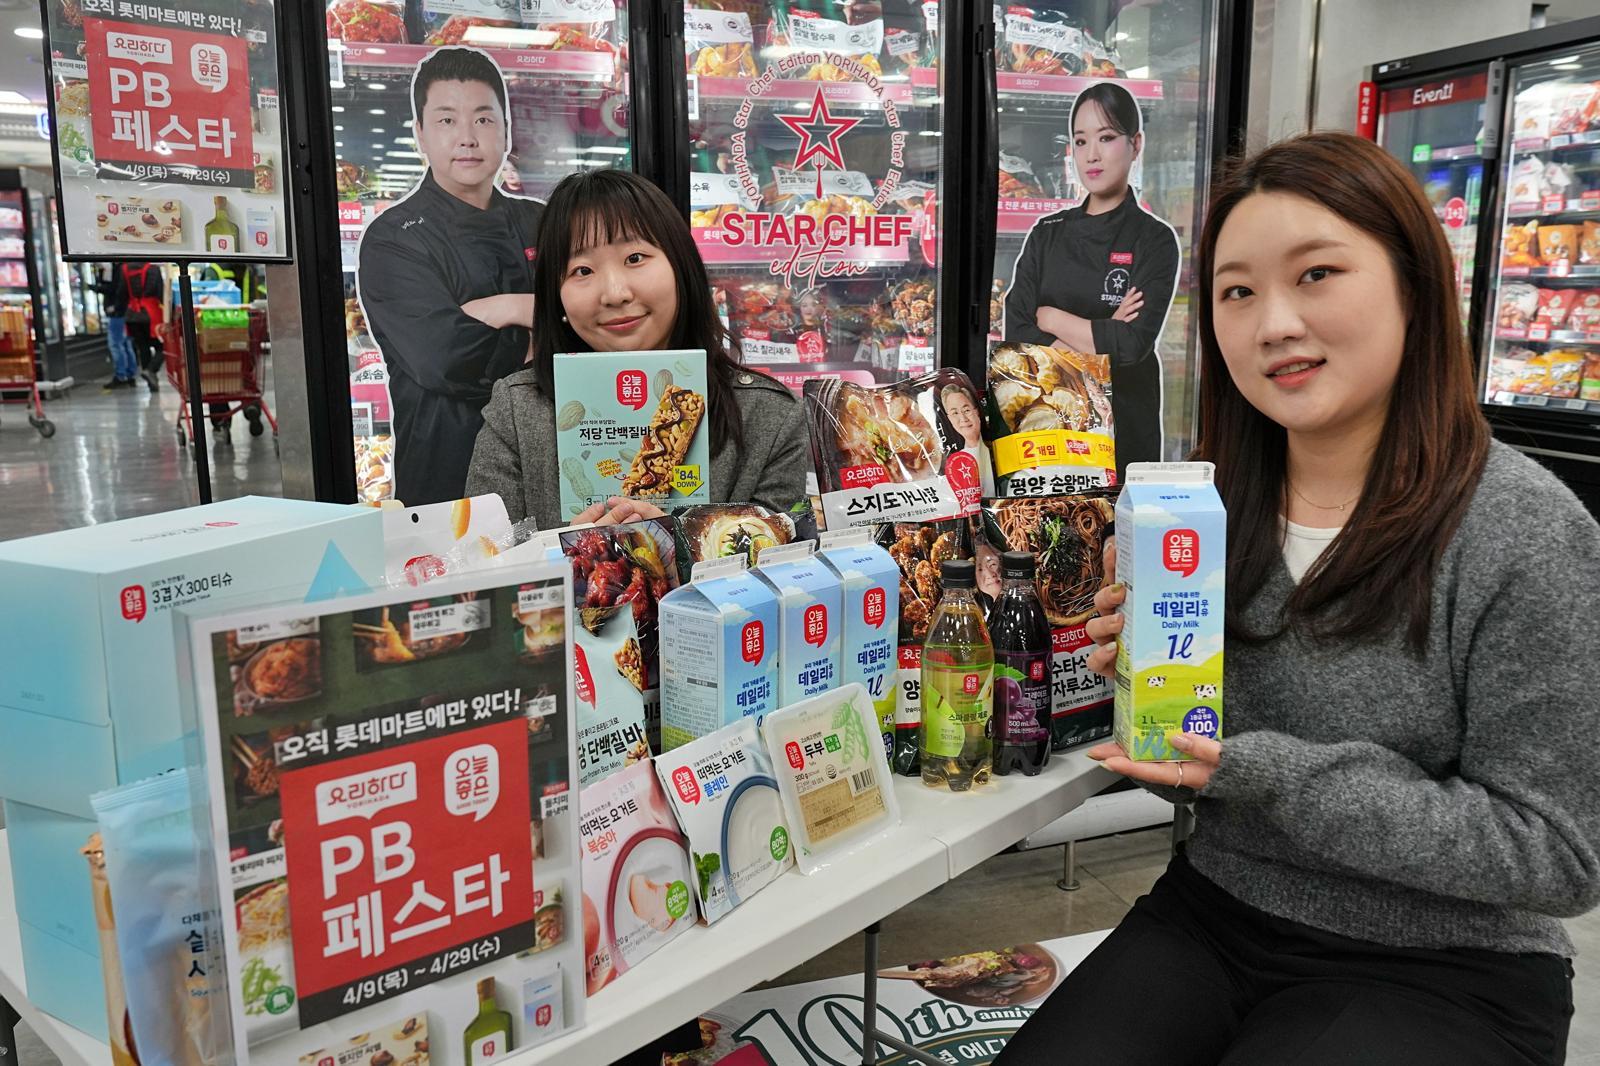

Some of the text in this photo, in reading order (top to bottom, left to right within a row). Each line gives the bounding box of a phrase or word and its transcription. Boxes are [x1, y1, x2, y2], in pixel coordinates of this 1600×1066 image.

[85, 0, 242, 34] 오직 롯데마트에만 있다!
[114, 37, 168, 54] 요리하다
[198, 49, 222, 66] 오늘
[198, 64, 222, 79] 좋은
[110, 67, 173, 108] PB
[1413, 83, 1455, 105] Event!
[111, 110, 238, 158] 페스타
[730, 53, 906, 210] YORIHADA Star Chef Edition YORIHADA Star Chef Edition
[1447, 207, 1464, 221] 1+1
[723, 213, 808, 248] STAR
[823, 215, 914, 247] CHEF
[769, 238, 868, 290] edition
[622, 374, 643, 387] 오늘
[622, 386, 643, 399] 좋은
[579, 425, 653, 441] 저당 단백질바
[845, 466, 885, 481] 요리하다
[677, 481, 697, 490] DOWN
[1010, 475, 1046, 496] 평양
[847, 486, 940, 516] 스지도가니탕
[1170, 534, 1193, 549] 오늘
[1170, 547, 1193, 563] 좋은
[152, 571, 234, 604] 3겹 X 300 티슈
[867, 592, 882, 605] 오늘
[1153, 598, 1209, 619] 데일리 우유
[809, 609, 824, 623] 오늘
[868, 602, 882, 618] 좋은
[745, 626, 761, 643] 오늘
[809, 619, 824, 636] 좋은
[1162, 620, 1200, 630] Daily Milk
[746, 639, 762, 654] 좋은
[1052, 628, 1086, 646] 요리하다
[858, 644, 887, 666] 데일리
[798, 664, 829, 687] 데일리
[863, 662, 887, 676] Daily Milk
[736, 683, 767, 707] 데일리
[804, 684, 829, 696] Daily Milk
[743, 703, 767, 718] Daily Milk
[281, 688, 521, 763] 오직 롯데마트에만 있다!
[587, 721, 645, 765] 단백질바
[804, 740, 825, 759] 두부
[455, 755, 489, 781] 오늘
[588, 760, 622, 778] Protein Bar Mini
[696, 761, 723, 780] 떠먹는
[721, 749, 747, 770] 요거트
[676, 770, 692, 786] 오늘
[703, 774, 730, 798] 플레인
[794, 773, 804, 782] 300
[327, 771, 408, 806] 요리하다
[455, 776, 489, 801] 좋은
[680, 781, 698, 797] 좋은
[580, 815, 611, 836] 떠먹는
[610, 798, 639, 823] 요거트
[587, 828, 617, 854] 복숭아
[319, 820, 416, 901] PB
[322, 853, 511, 959] 페스타
[342, 968, 409, 1005] 4/9(목)
[429, 935, 501, 975] 4/29(수)
[978, 1005, 1036, 1029] anniv
